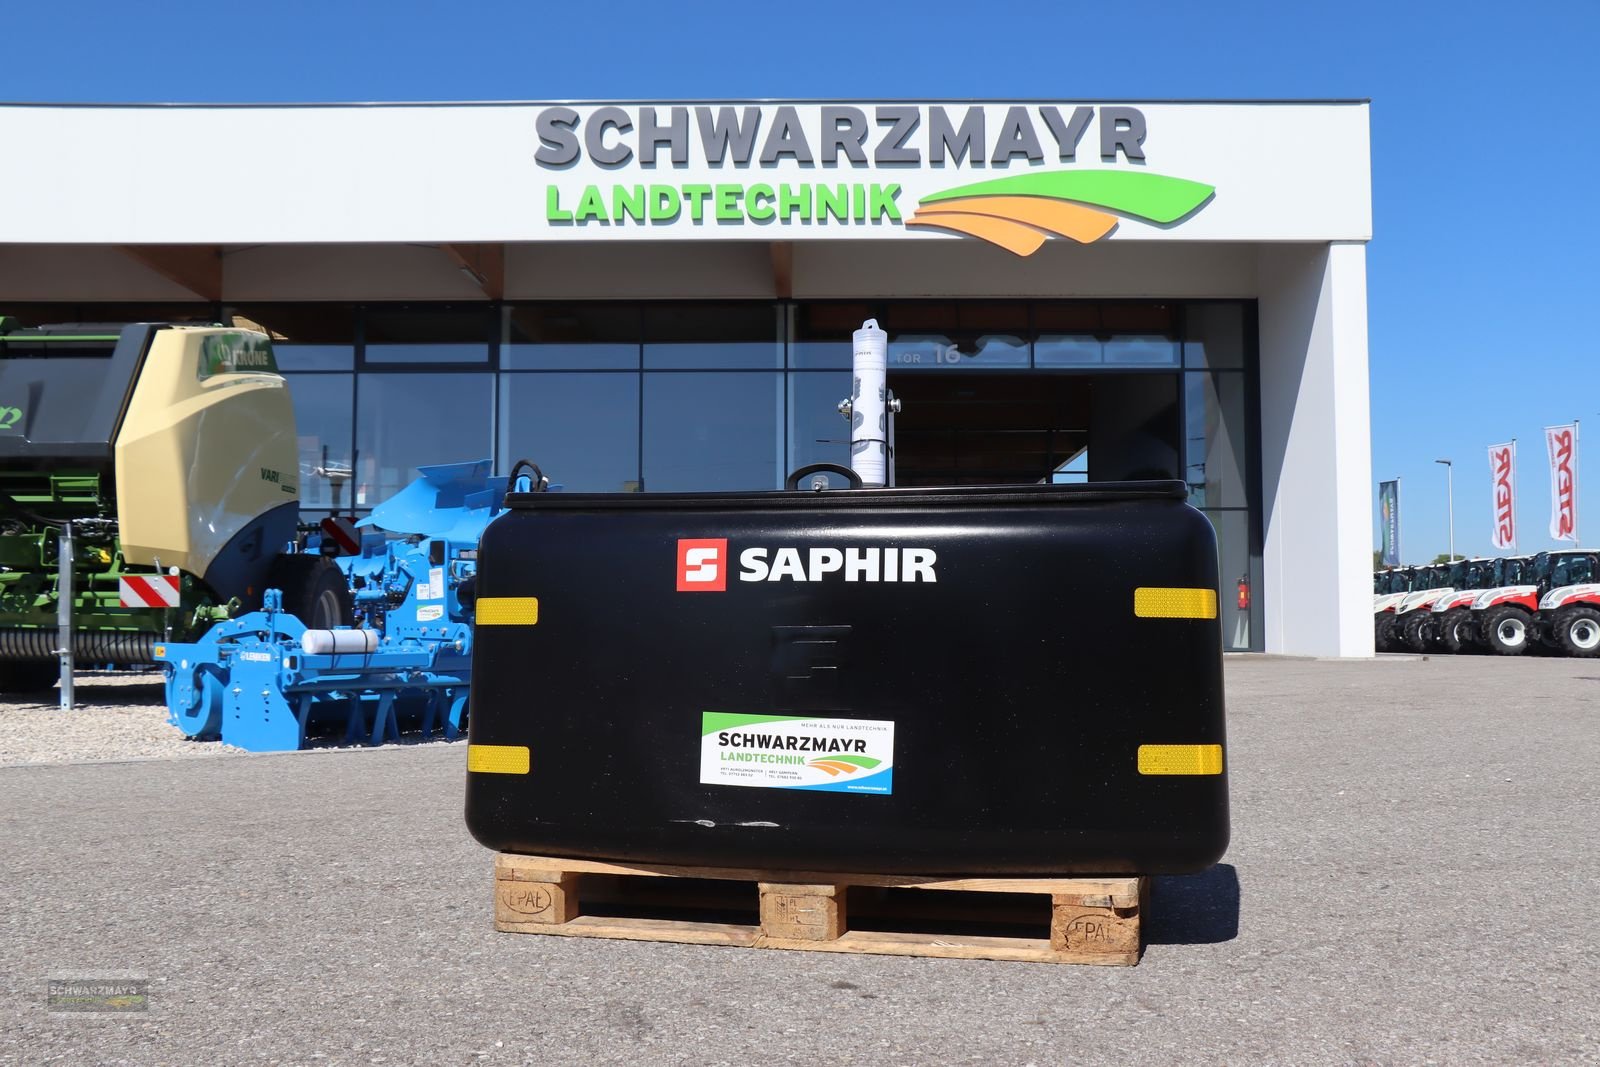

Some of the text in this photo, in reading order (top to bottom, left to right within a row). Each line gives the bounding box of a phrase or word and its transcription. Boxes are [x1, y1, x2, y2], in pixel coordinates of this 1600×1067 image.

[534, 105, 1148, 167] SCHWARZMAYR
[546, 183, 903, 223] LANDTECHNIK
[232, 349, 269, 366] KRONE
[896, 343, 961, 364] TOR 16
[739, 547, 937, 583] SAPHIR
[718, 732, 867, 753] SCHWARZMAYR
[720, 752, 806, 766] LANDTECHNIK
